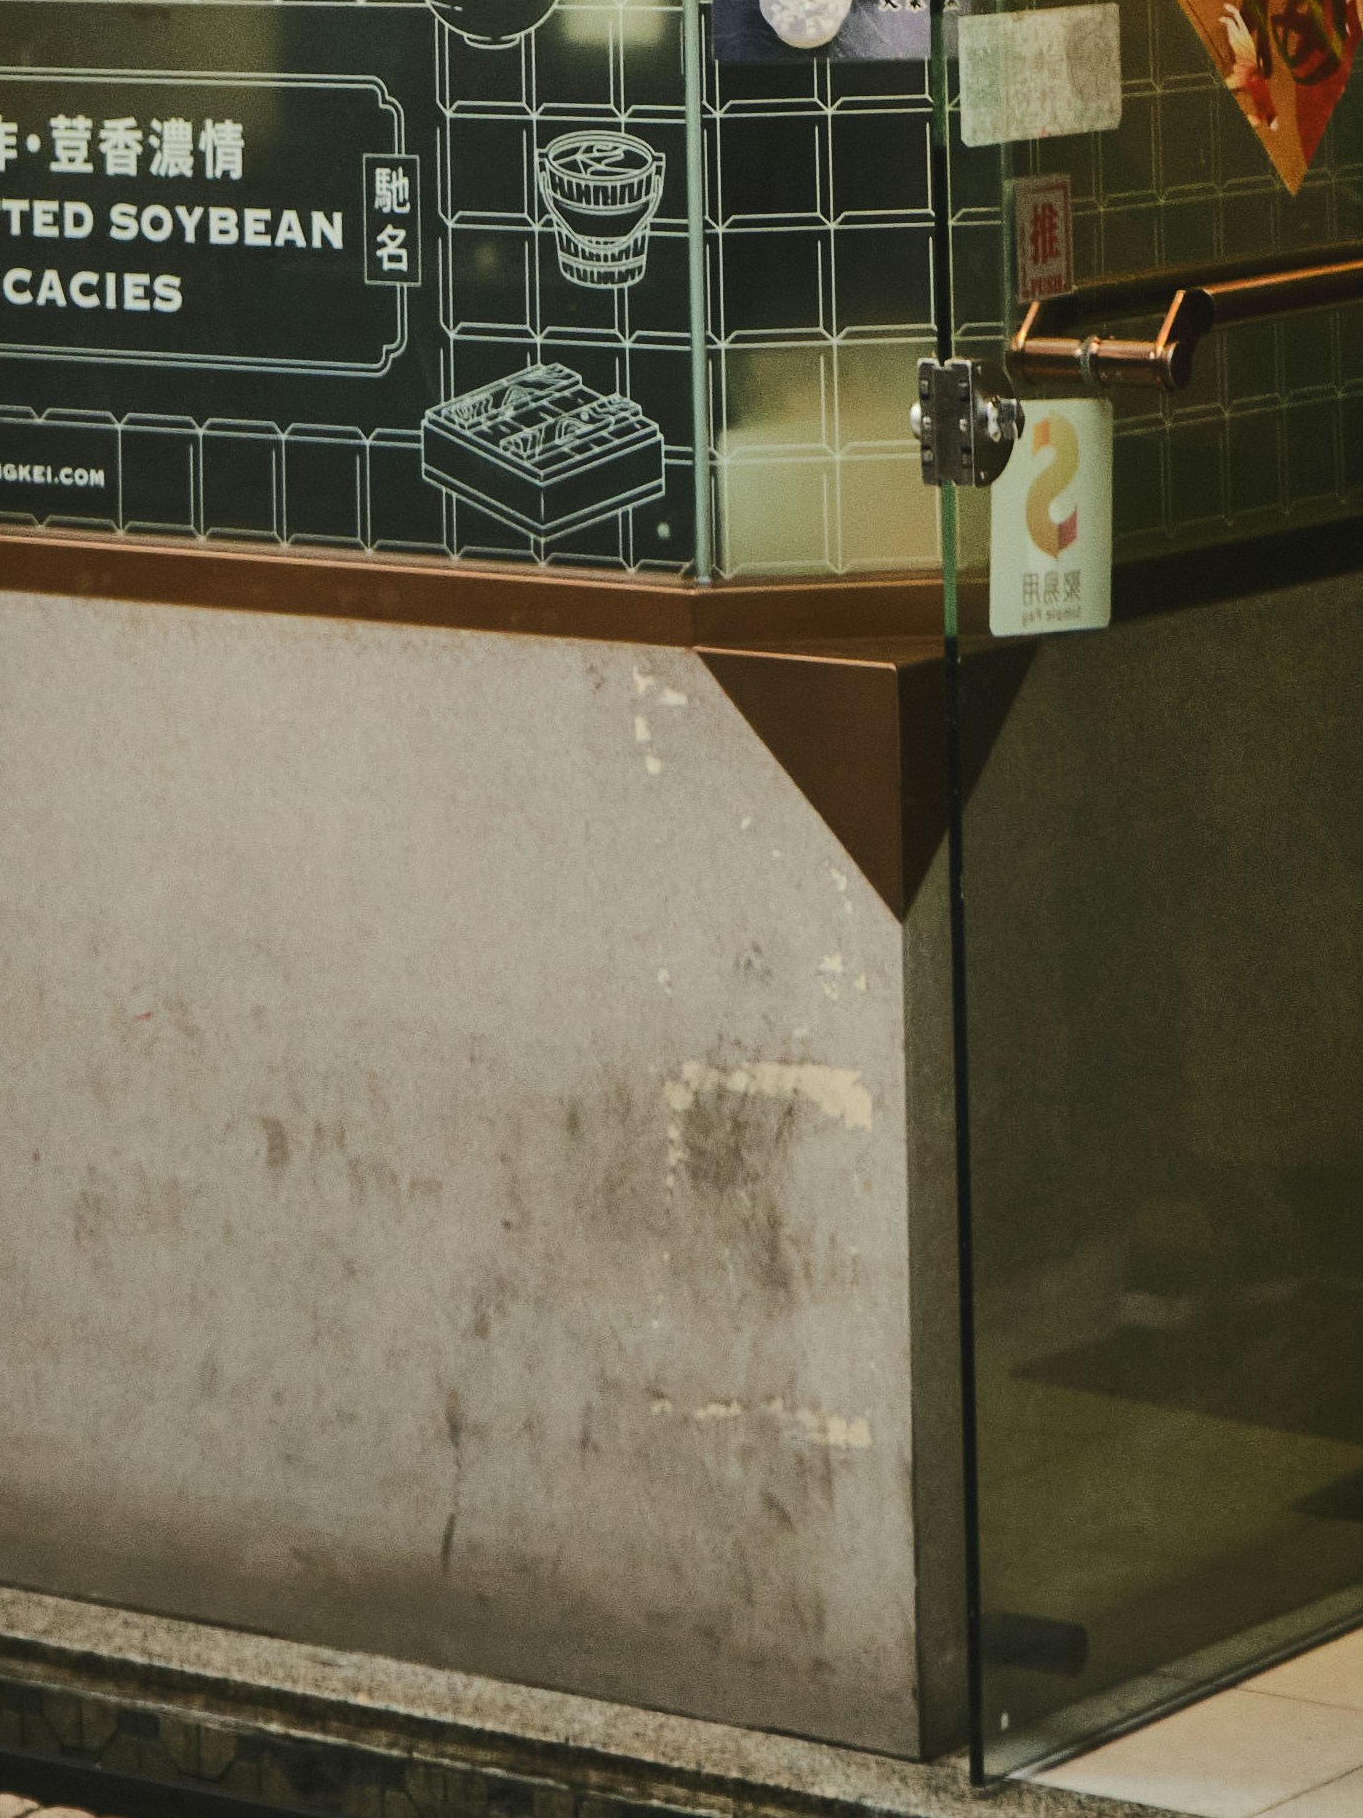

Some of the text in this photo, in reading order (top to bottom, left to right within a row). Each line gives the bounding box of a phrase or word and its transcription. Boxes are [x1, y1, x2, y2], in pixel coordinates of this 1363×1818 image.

[109, 202, 344, 250] SOYBEAN
[374, 165, 411, 273] 馳名
[1030, 201, 1061, 265] 推
